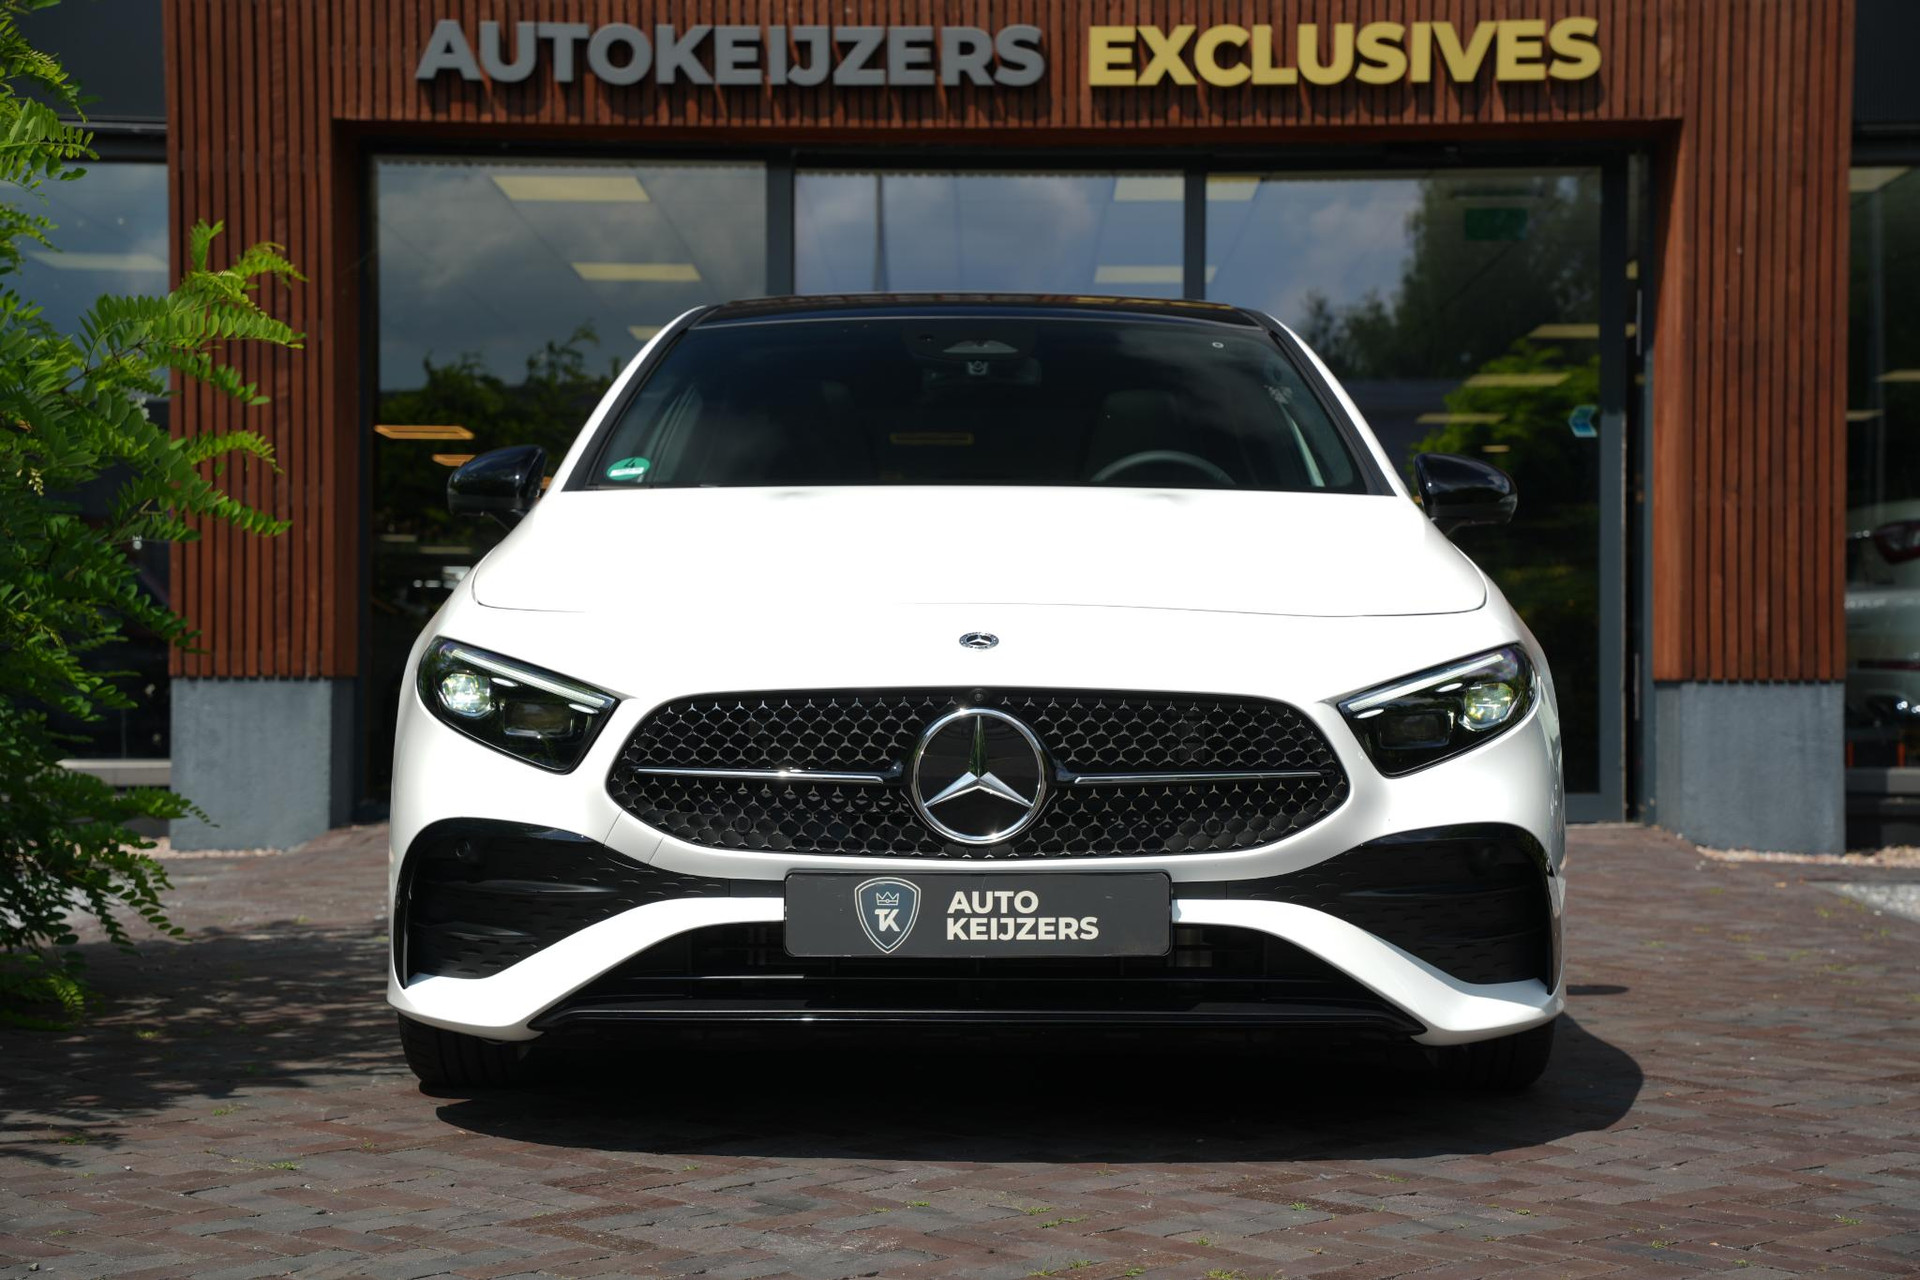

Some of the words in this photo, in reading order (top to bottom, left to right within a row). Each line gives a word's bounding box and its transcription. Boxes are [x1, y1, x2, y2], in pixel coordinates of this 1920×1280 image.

[415, 19, 1046, 86] AUTOKEIJZERS
[1089, 17, 1601, 87] EXCLUSIVES
[947, 890, 1039, 914] AUTO
[874, 908, 900, 932] TK
[946, 916, 1099, 941] KEIJZERS
